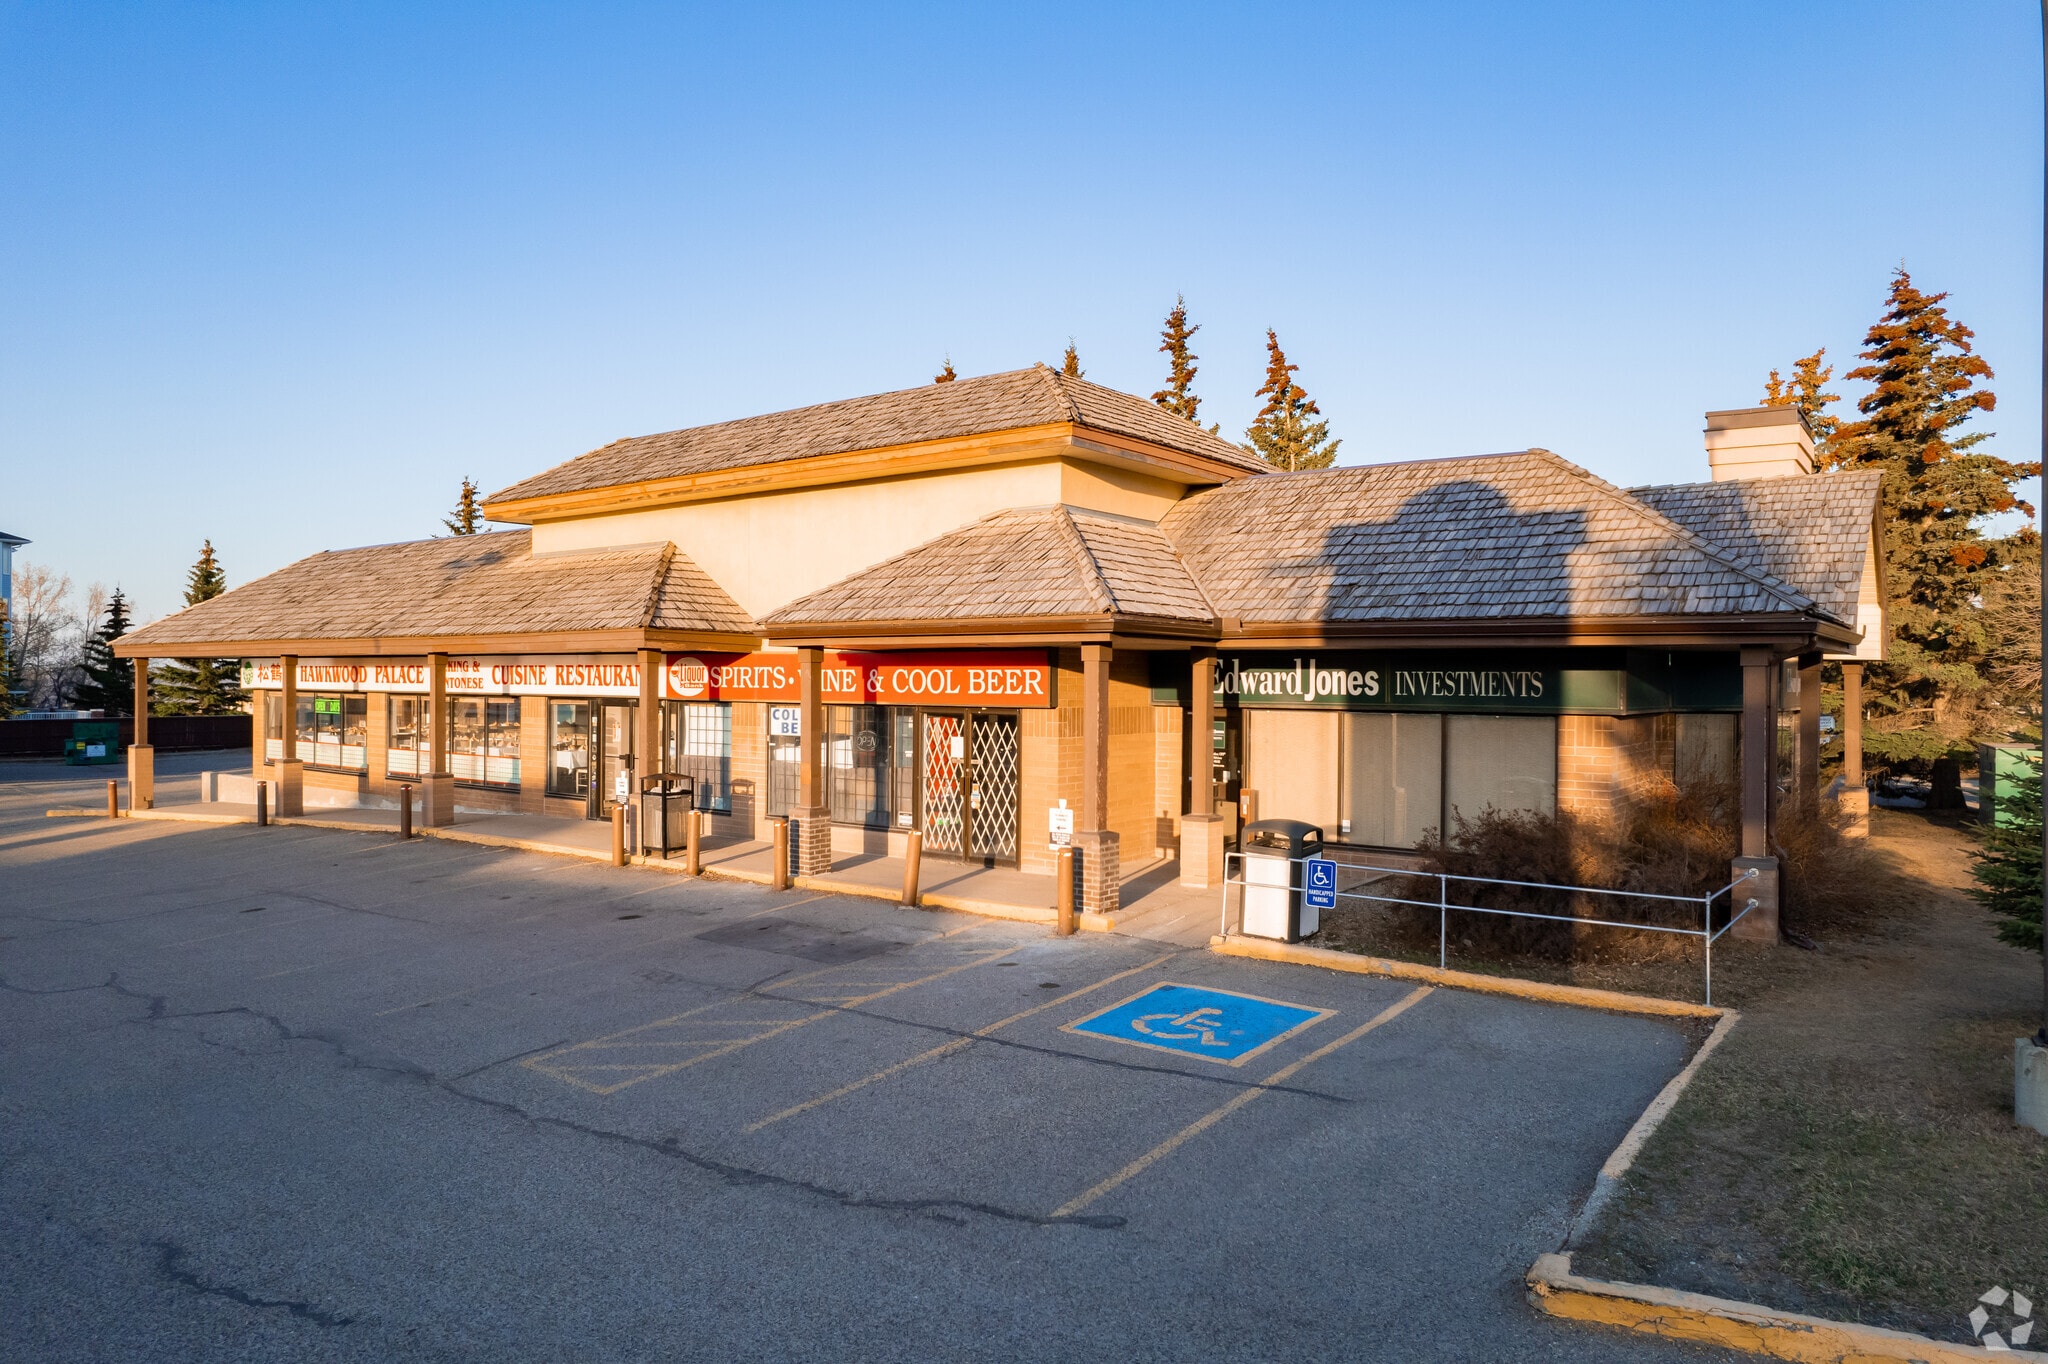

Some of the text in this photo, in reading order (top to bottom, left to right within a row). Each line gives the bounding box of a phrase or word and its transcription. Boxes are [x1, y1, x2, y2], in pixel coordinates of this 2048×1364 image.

[446, 660, 481, 672] KING &
[680, 663, 705, 684] Liquor
[300, 665, 424, 684] HAWKWOOD PALACE
[492, 664, 640, 687] CUISINE RESTAURAN
[710, 666, 1044, 695] SPIRITS INE & COOL BEER
[444, 677, 484, 689] NTONESE
[1394, 671, 1543, 697] INVESTMENTS
[772, 709, 798, 720] COL
[781, 722, 798, 734] BE
[1308, 889, 1334, 897] HANDICAPPED
